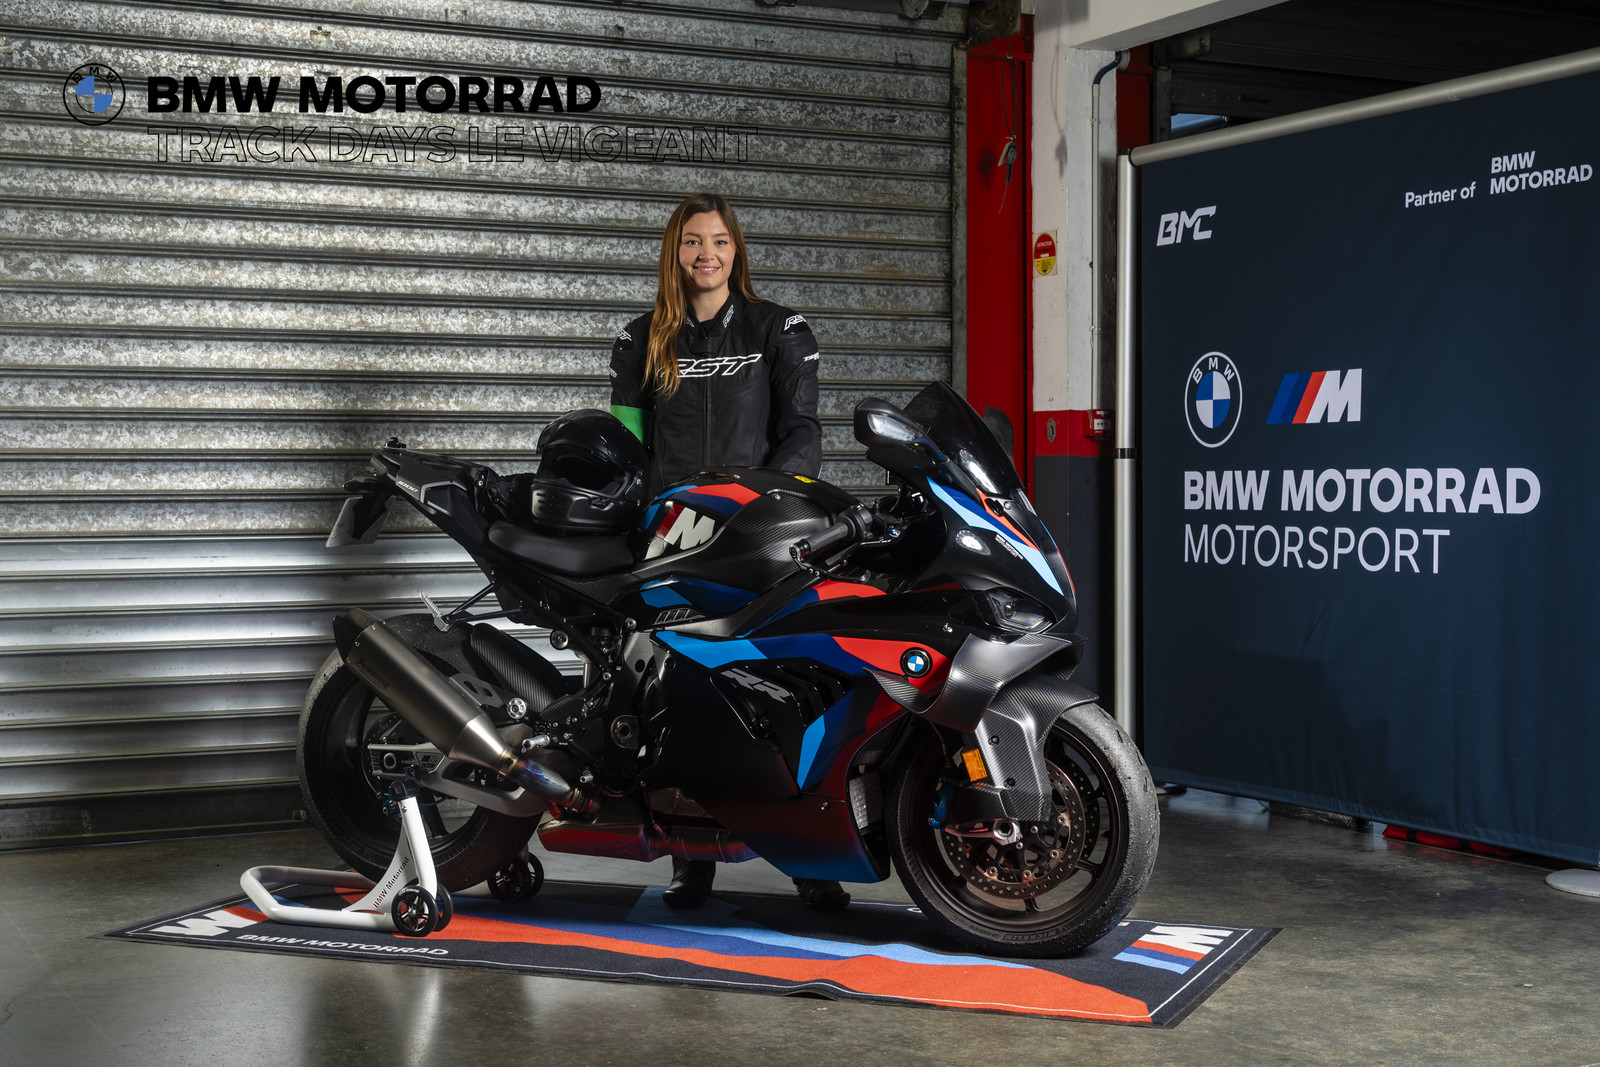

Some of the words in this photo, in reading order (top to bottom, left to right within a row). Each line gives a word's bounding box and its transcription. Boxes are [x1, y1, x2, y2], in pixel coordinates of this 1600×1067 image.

[1490, 151, 1536, 174] BMW
[1405, 188, 1457, 208] Partner
[1460, 181, 1476, 200] of
[1489, 164, 1593, 195] MOTORRAD
[1156, 205, 1217, 247] BMC
[784, 314, 807, 331] RS
[1192, 357, 1236, 385] BMW
[1304, 367, 1363, 424] M
[1184, 470, 1270, 511] BMW
[1281, 467, 1541, 515] MOTORRAD
[664, 506, 716, 551] M
[1184, 523, 1451, 575] MOTORSPORT
[720, 667, 791, 704] RR
[385, 857, 409, 890] Motorrad
[236, 934, 304, 945] BMW
[302, 939, 449, 955] MOTORRAD
